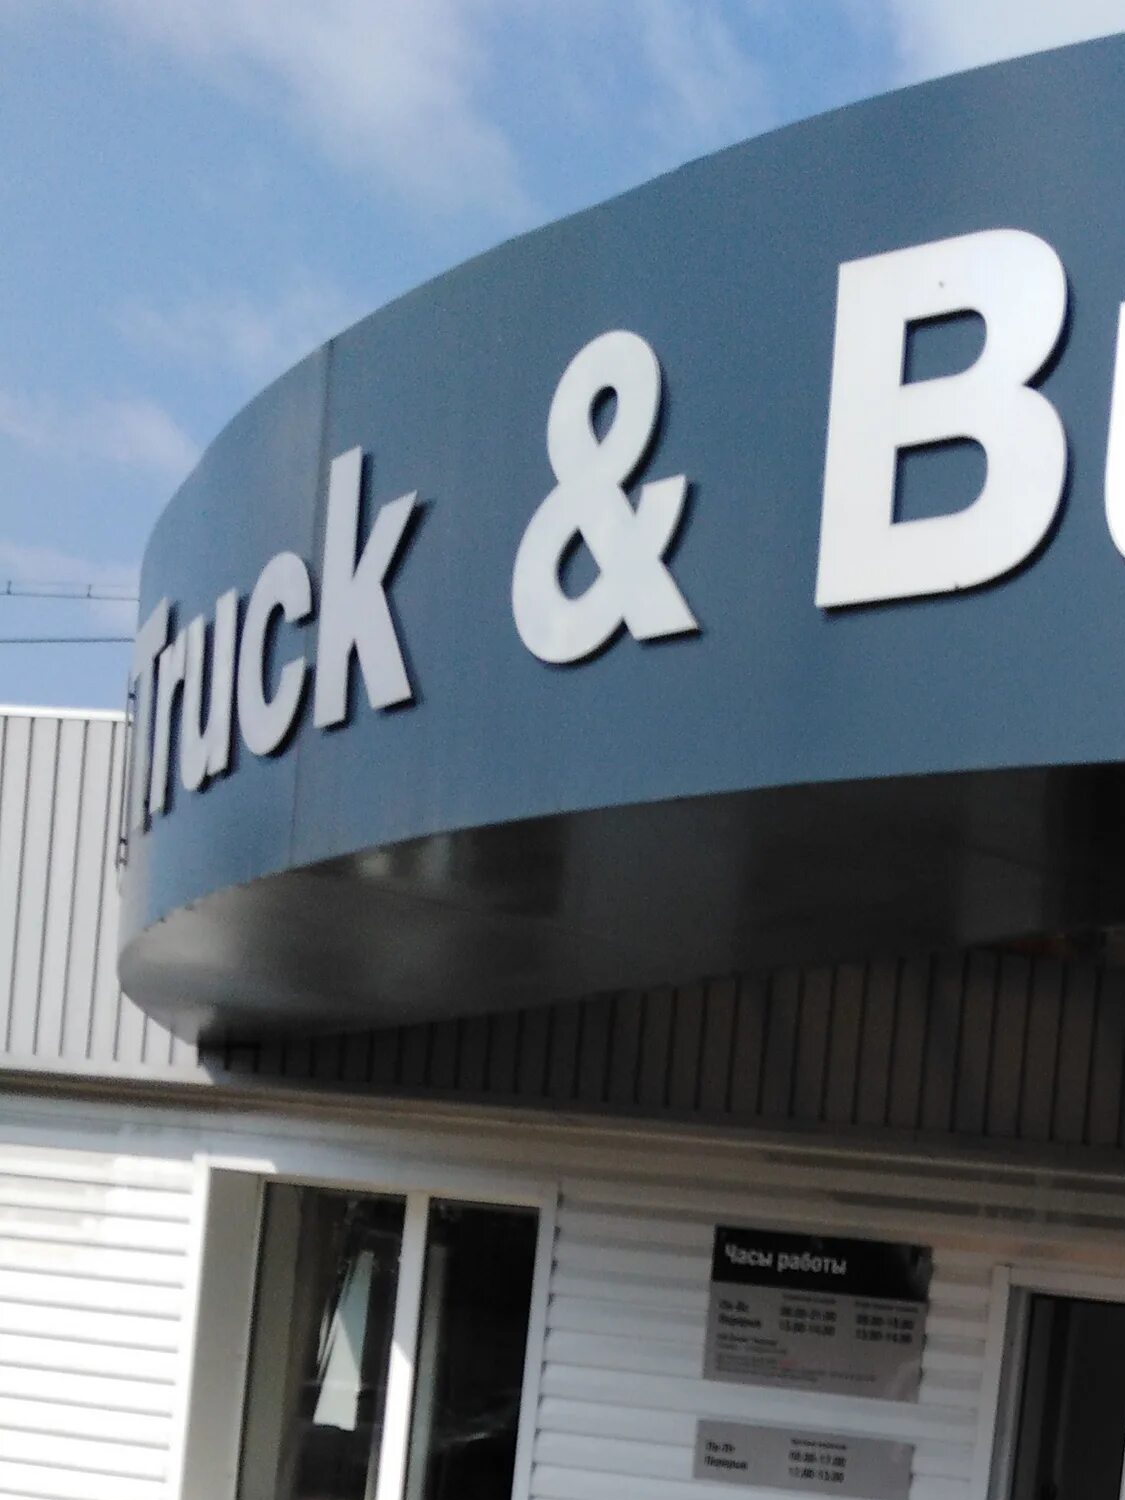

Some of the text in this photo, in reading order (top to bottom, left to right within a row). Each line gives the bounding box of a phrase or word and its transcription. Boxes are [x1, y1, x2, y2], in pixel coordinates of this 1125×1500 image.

[131, 446, 417, 836] Truck
[512, 329, 700, 664] &
[725, 1243, 847, 1275] Часы работы
